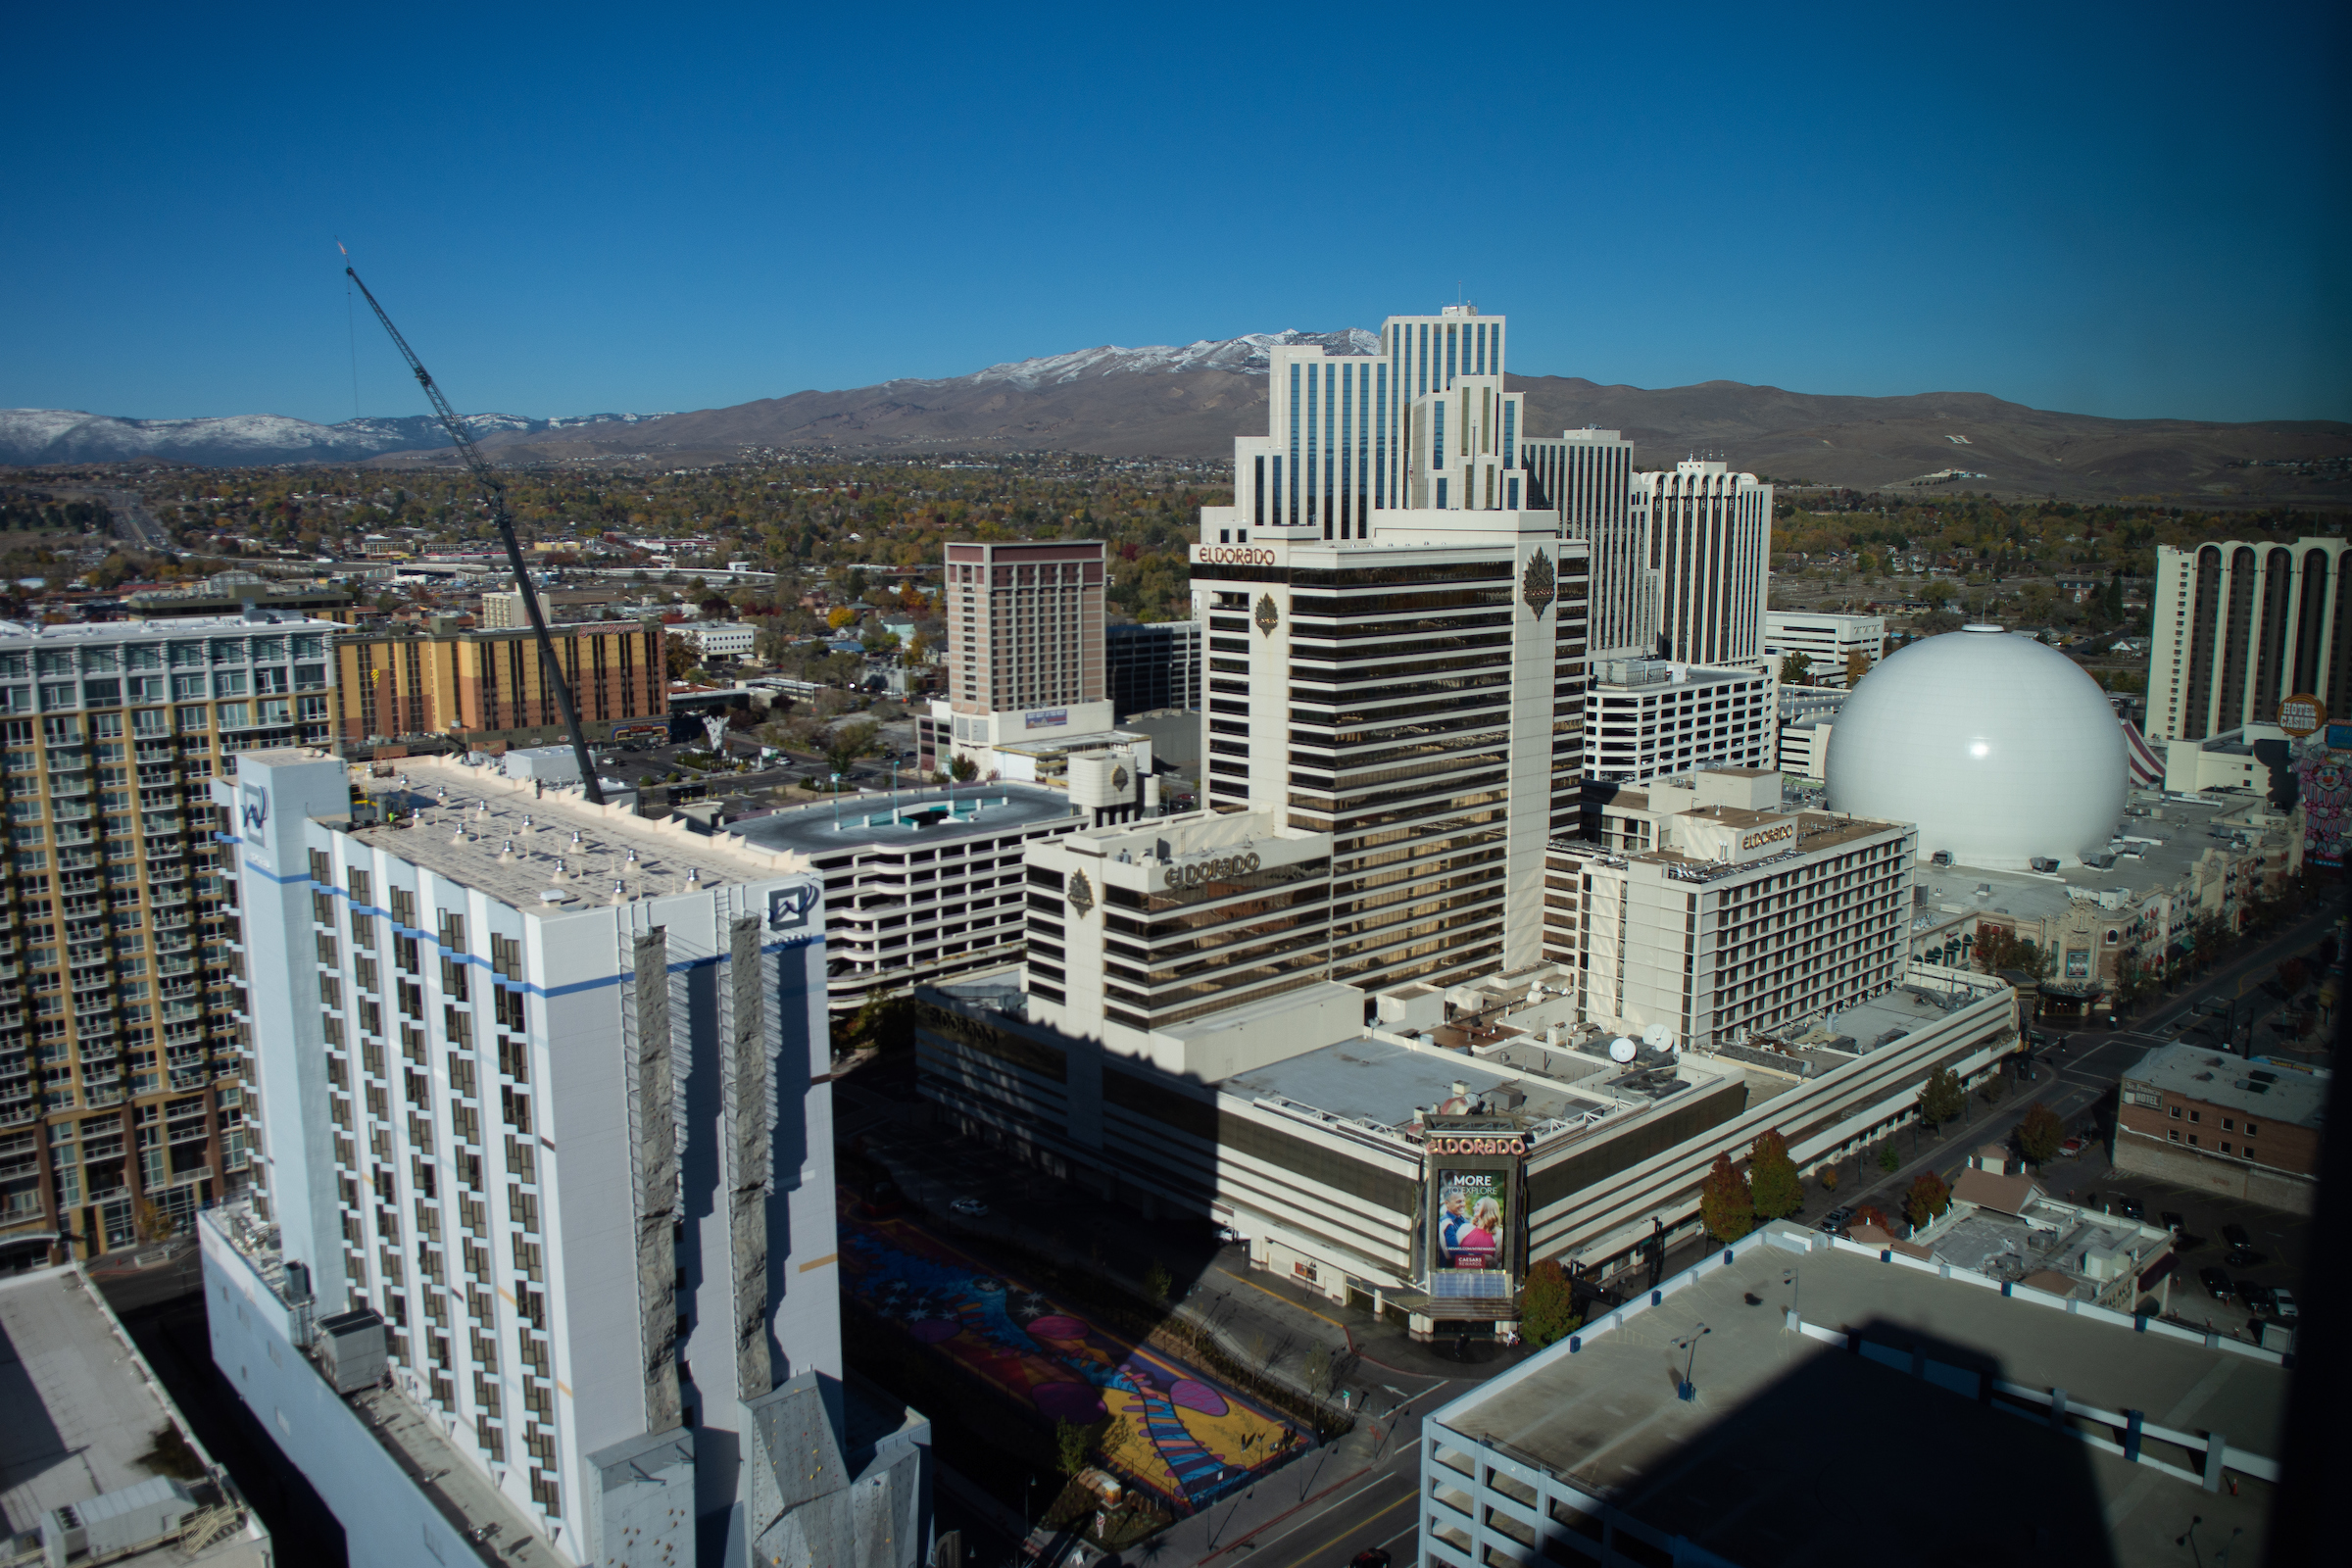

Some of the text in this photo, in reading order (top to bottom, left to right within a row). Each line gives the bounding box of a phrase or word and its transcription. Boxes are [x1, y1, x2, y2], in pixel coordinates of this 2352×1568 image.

[2282, 703, 2317, 716] HOTEL
[2279, 715, 2317, 730] CASINO
[2135, 1092, 2159, 1105] HOTEL
[1453, 1175, 1492, 1186] MORE
[1447, 1186, 1497, 1195] TO EXPLORE
